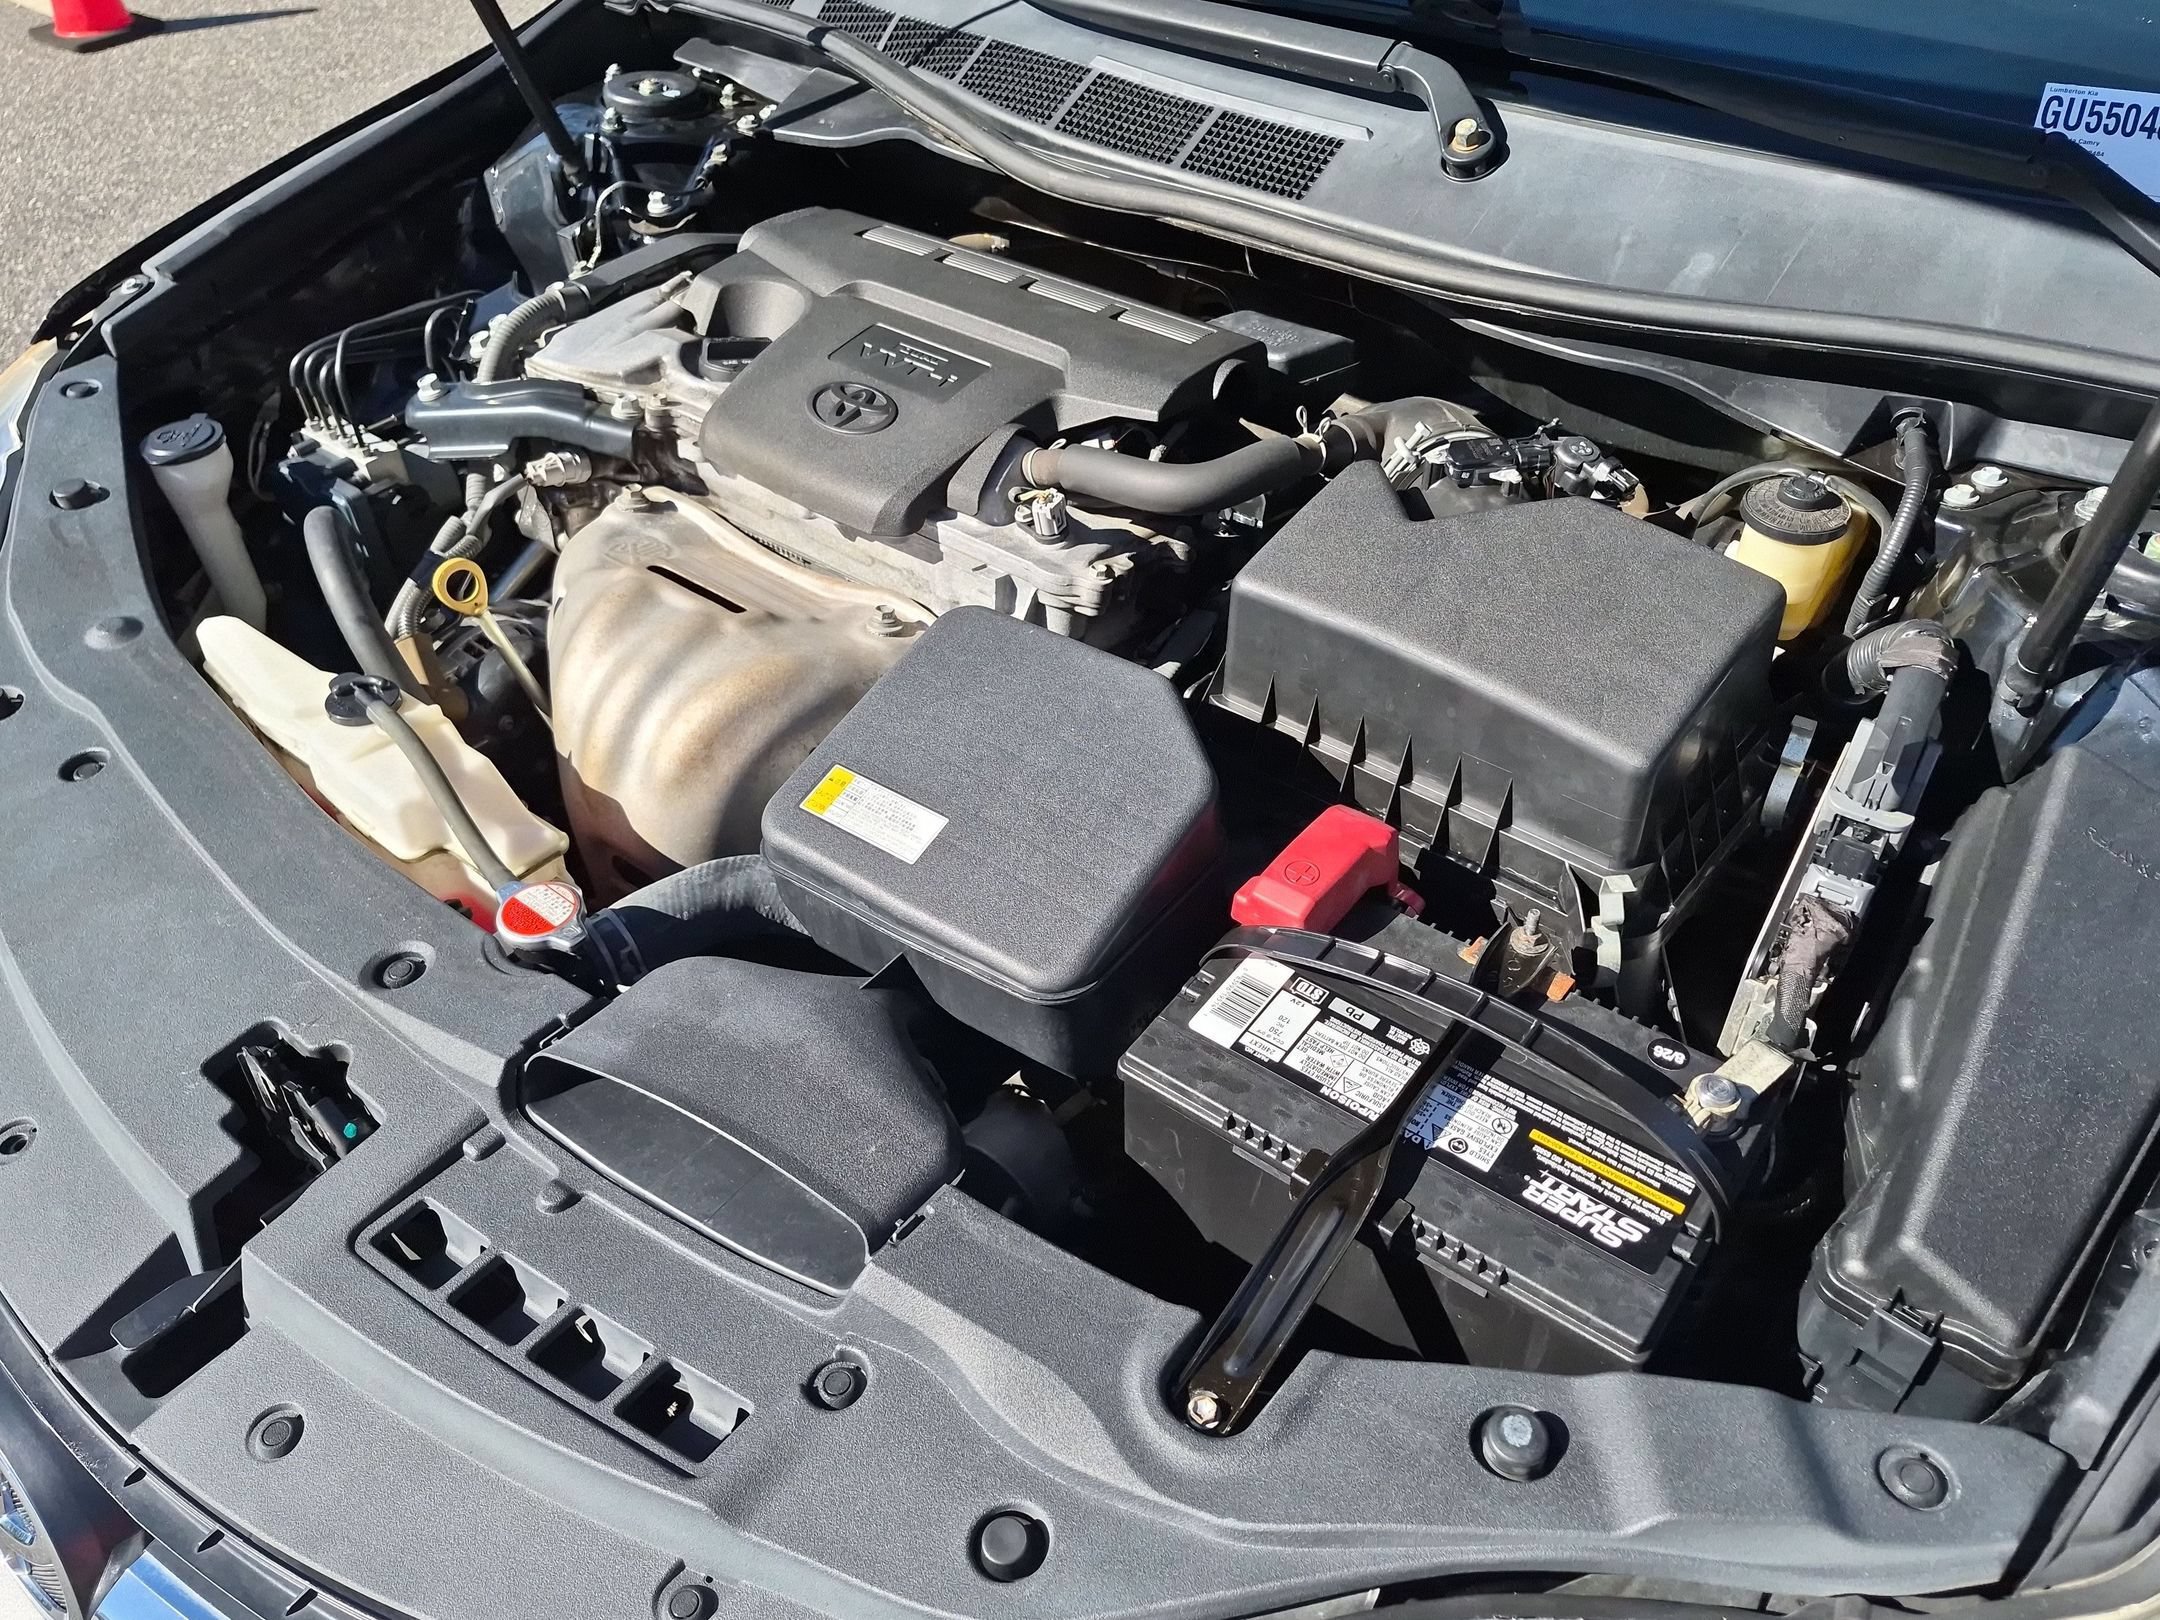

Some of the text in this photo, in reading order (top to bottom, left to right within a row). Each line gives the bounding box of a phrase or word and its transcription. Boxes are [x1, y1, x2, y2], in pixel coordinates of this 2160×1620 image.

[2050, 86, 2086, 95] Lumberton
[2041, 95, 2160, 139] GU5504
[2079, 138, 2100, 146] Camry
[1294, 979, 1325, 1000] STD
[1289, 996, 1306, 1008] 12V
[1276, 1013, 1292, 1024] 120
[1342, 1005, 1365, 1021] Pb
[1274, 1020, 1285, 1028] RC
[1267, 1025, 1284, 1037] 750
[1247, 1037, 1276, 1055] 24REXT
[1271, 1035, 1285, 1045] CCA
[1333, 1039, 1349, 1051] OPEN
[1295, 1043, 1309, 1053] GET
[1299, 1039, 1326, 1056] MEDICAL
[1318, 1042, 1335, 1054] HELP
[1346, 1046, 1359, 1056] NOT
[1350, 1042, 1362, 1052] NOT
[1359, 1047, 1370, 1056] DO
[1251, 1050, 1270, 1063] PART
[1356, 1051, 1367, 1060] DO
[1298, 1057, 1338, 1081] IMMEDIATELY
[1299, 1064, 1334, 1086] FLUSH EYES
[1323, 1064, 1341, 1077] WITH
[1383, 1065, 1409, 1082] READ ALL
[1357, 1070, 1395, 1092] BLINDNESS OR
[1377, 1074, 1398, 1088] SEVERE
[1362, 1079, 1391, 1098] CAN CAUSE
[1353, 1089, 1384, 1109] SULFURIC
[1371, 1091, 1388, 1103] ACID
[1445, 1097, 1457, 1107] THE
[1454, 1102, 1465, 1111] OF
[1462, 1106, 1476, 1117] OUT
[1442, 1112, 1474, 1132] BLINDNESS
[1474, 1112, 1489, 1123] KEEP
[1444, 1120, 1499, 1153] EXPLOSIVE GASES
[1471, 1127, 1492, 1141] CAUSE
[1489, 1136, 1503, 1147] CAN
[1467, 1148, 1491, 1165] SHIELD
[1579, 1154, 1598, 1168] CALL
[1596, 1163, 1635, 1187] WARRANTY
[1633, 1182, 1676, 1208] NATIONWIDE
[1524, 1167, 1651, 1247] START
[1517, 1181, 1627, 1251] SUPER
